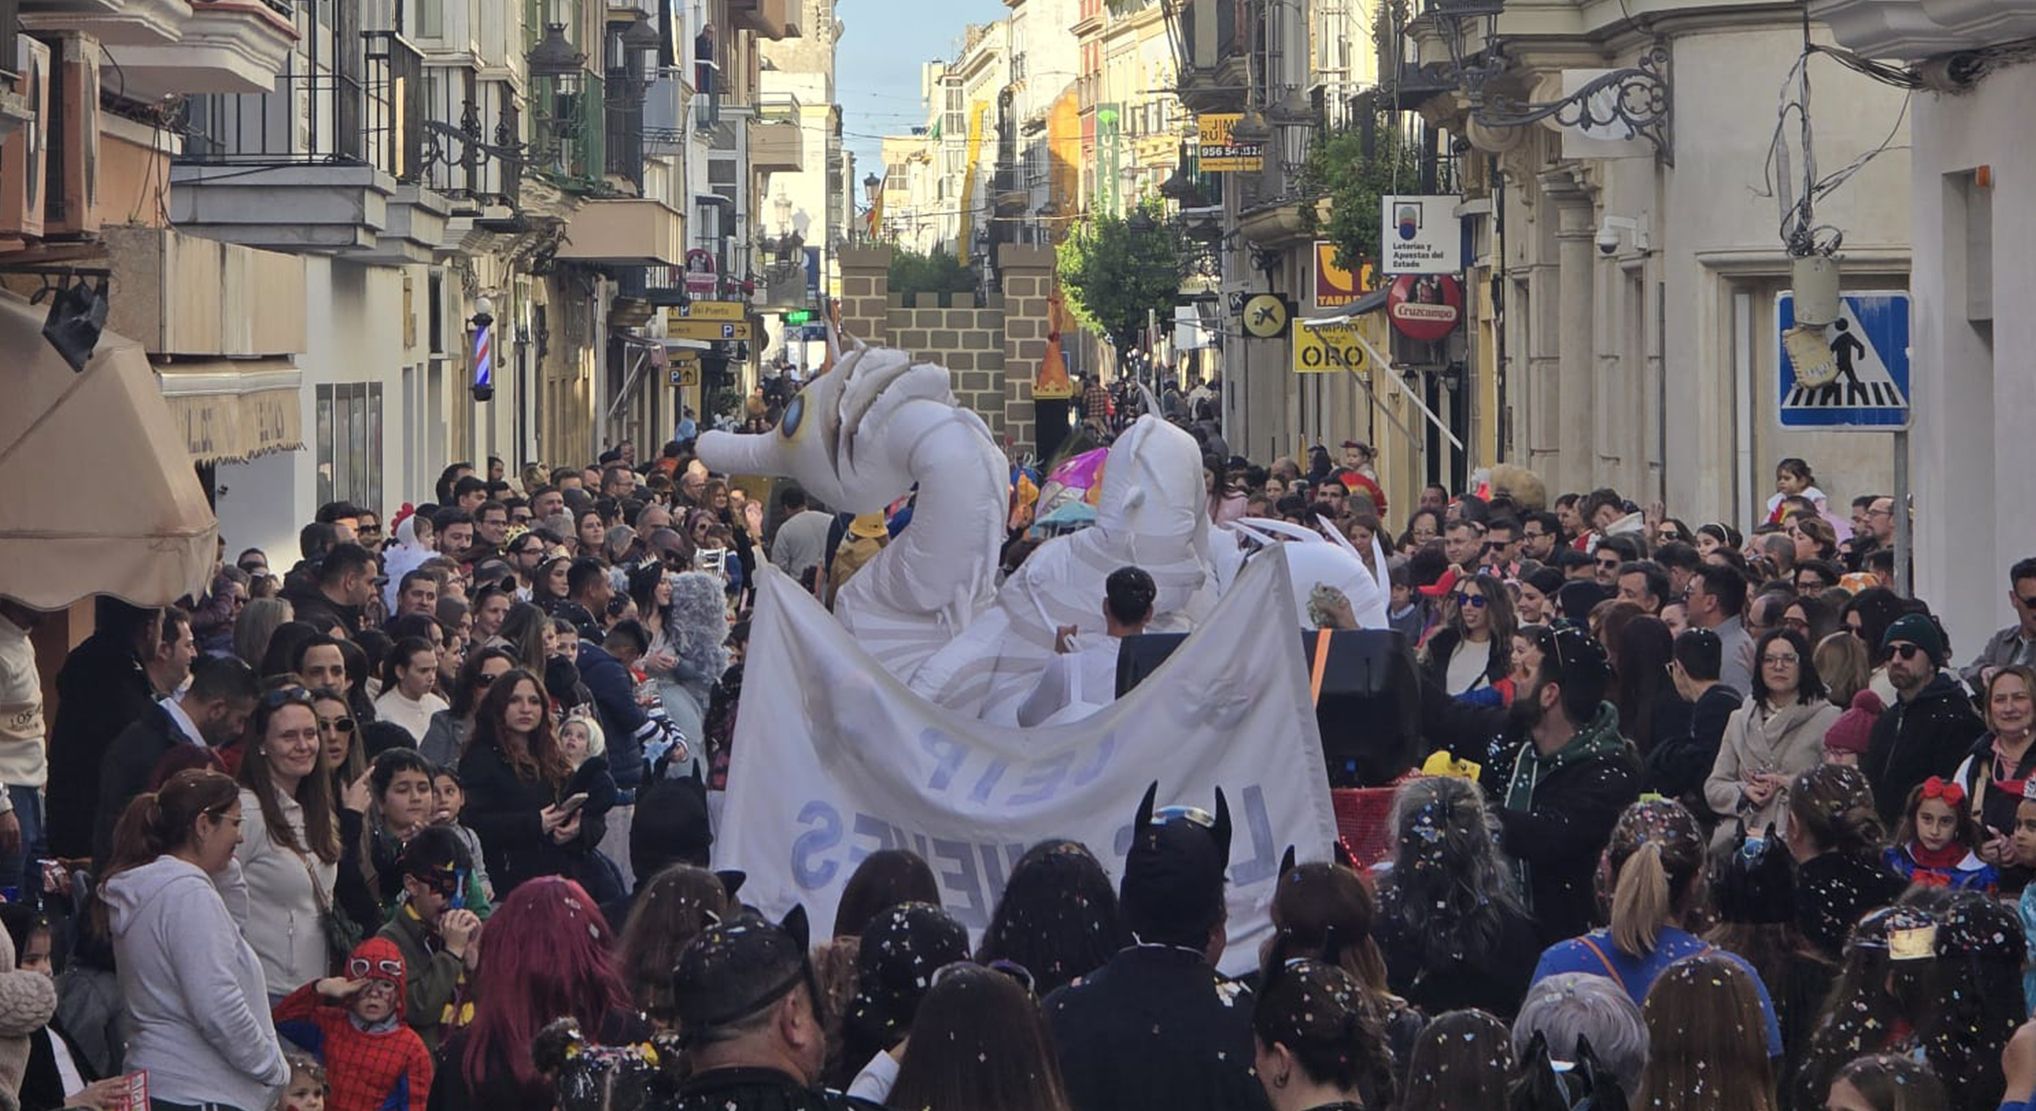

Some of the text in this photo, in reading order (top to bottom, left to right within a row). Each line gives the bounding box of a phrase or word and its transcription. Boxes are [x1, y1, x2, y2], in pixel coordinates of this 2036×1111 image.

[1393, 251, 1444, 260] Apuestas del
[1393, 260, 1420, 268] Estado
[1398, 305, 1452, 319] Cruzcampo
[1302, 345, 1364, 367] ORO
